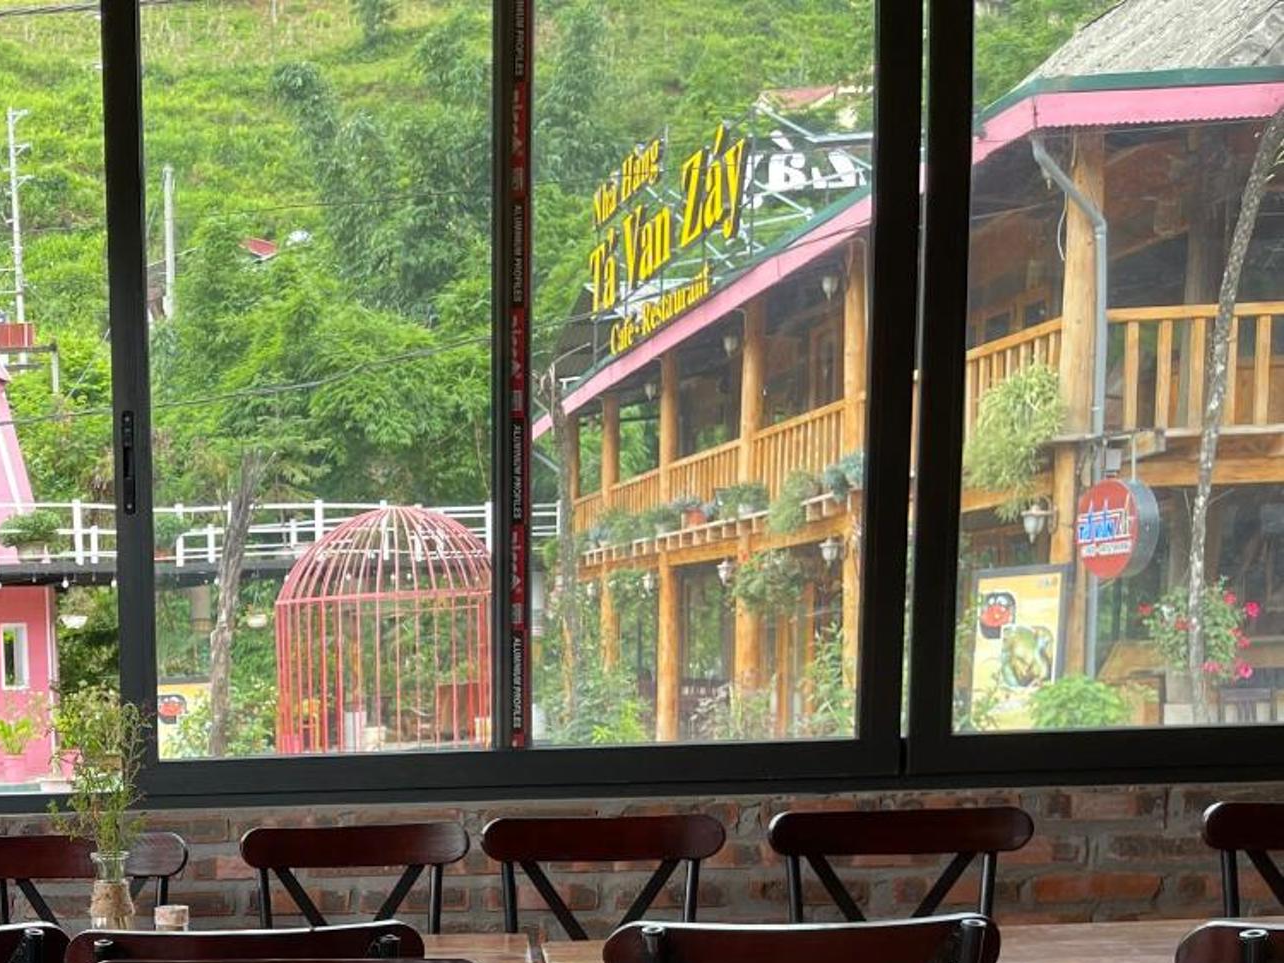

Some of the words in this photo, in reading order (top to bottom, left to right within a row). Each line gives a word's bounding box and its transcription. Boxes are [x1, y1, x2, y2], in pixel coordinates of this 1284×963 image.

[623, 205, 671, 291] Van
[513, 258, 523, 302] PROFILES
[641, 262, 710, 337] Restaurant
[513, 475, 522, 519] PROFILES
[513, 637, 522, 685] ALUMINIUM
[513, 686, 522, 729] PROFILES
